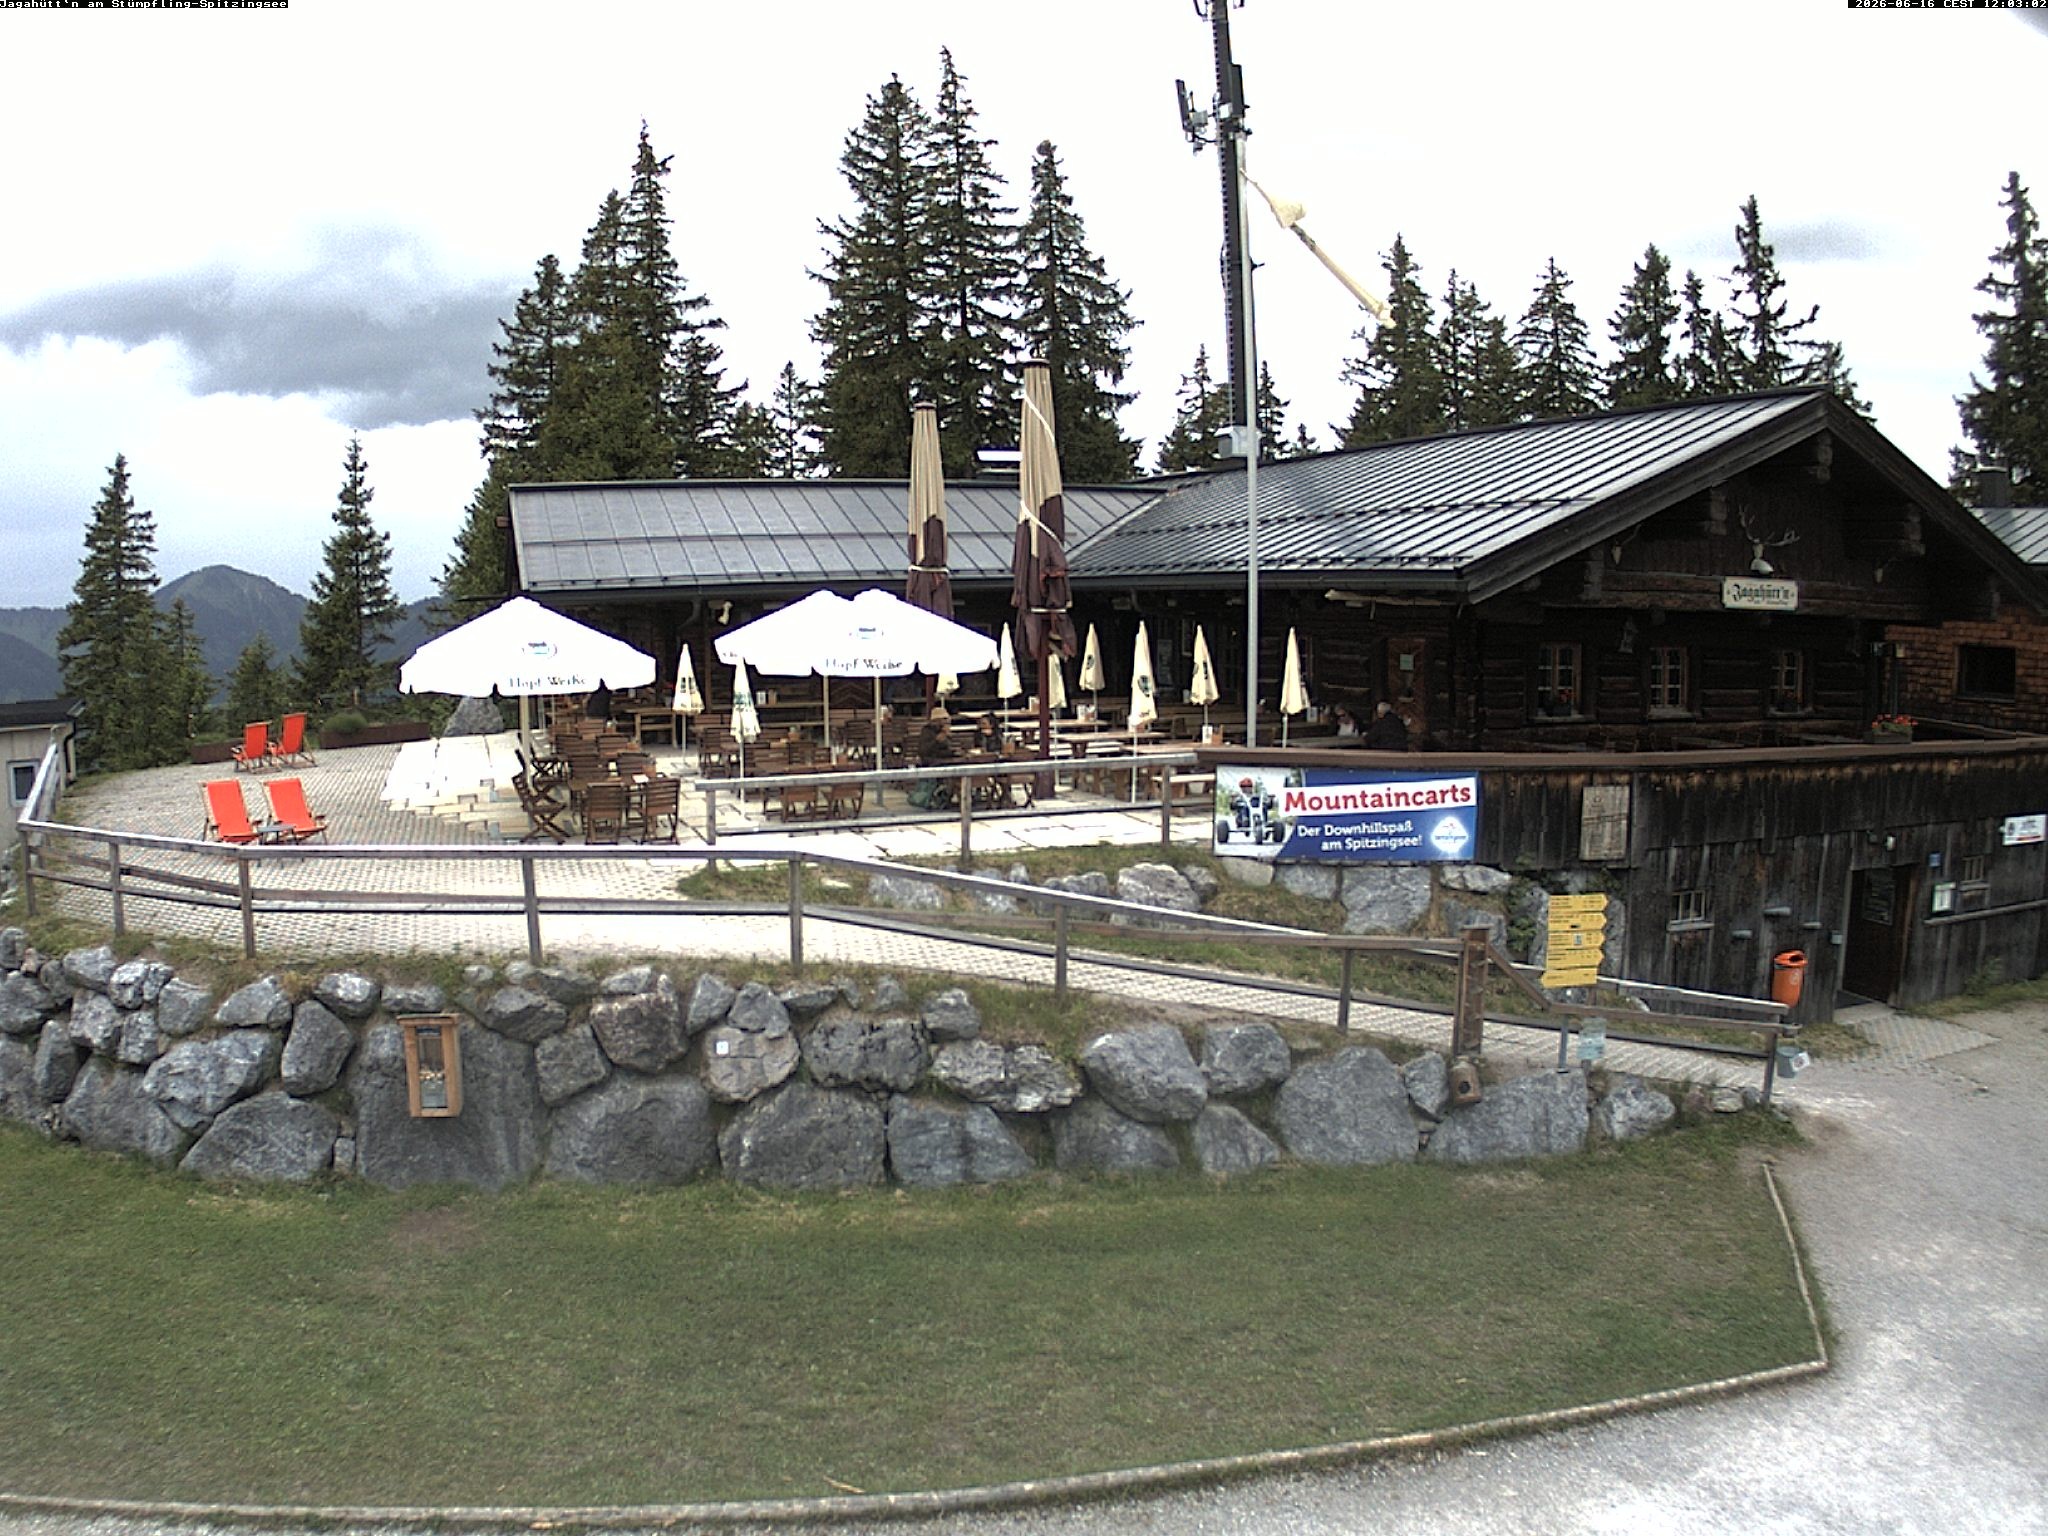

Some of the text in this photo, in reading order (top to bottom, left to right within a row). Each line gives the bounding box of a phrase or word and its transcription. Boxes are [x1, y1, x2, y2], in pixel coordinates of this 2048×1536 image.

[1284, 784, 1471, 812] Mountaincarts
[1297, 820, 1414, 837] Der Downhillspaß
[1321, 840, 1342, 852] am
[1344, 834, 1423, 852] Spitzingsee!
